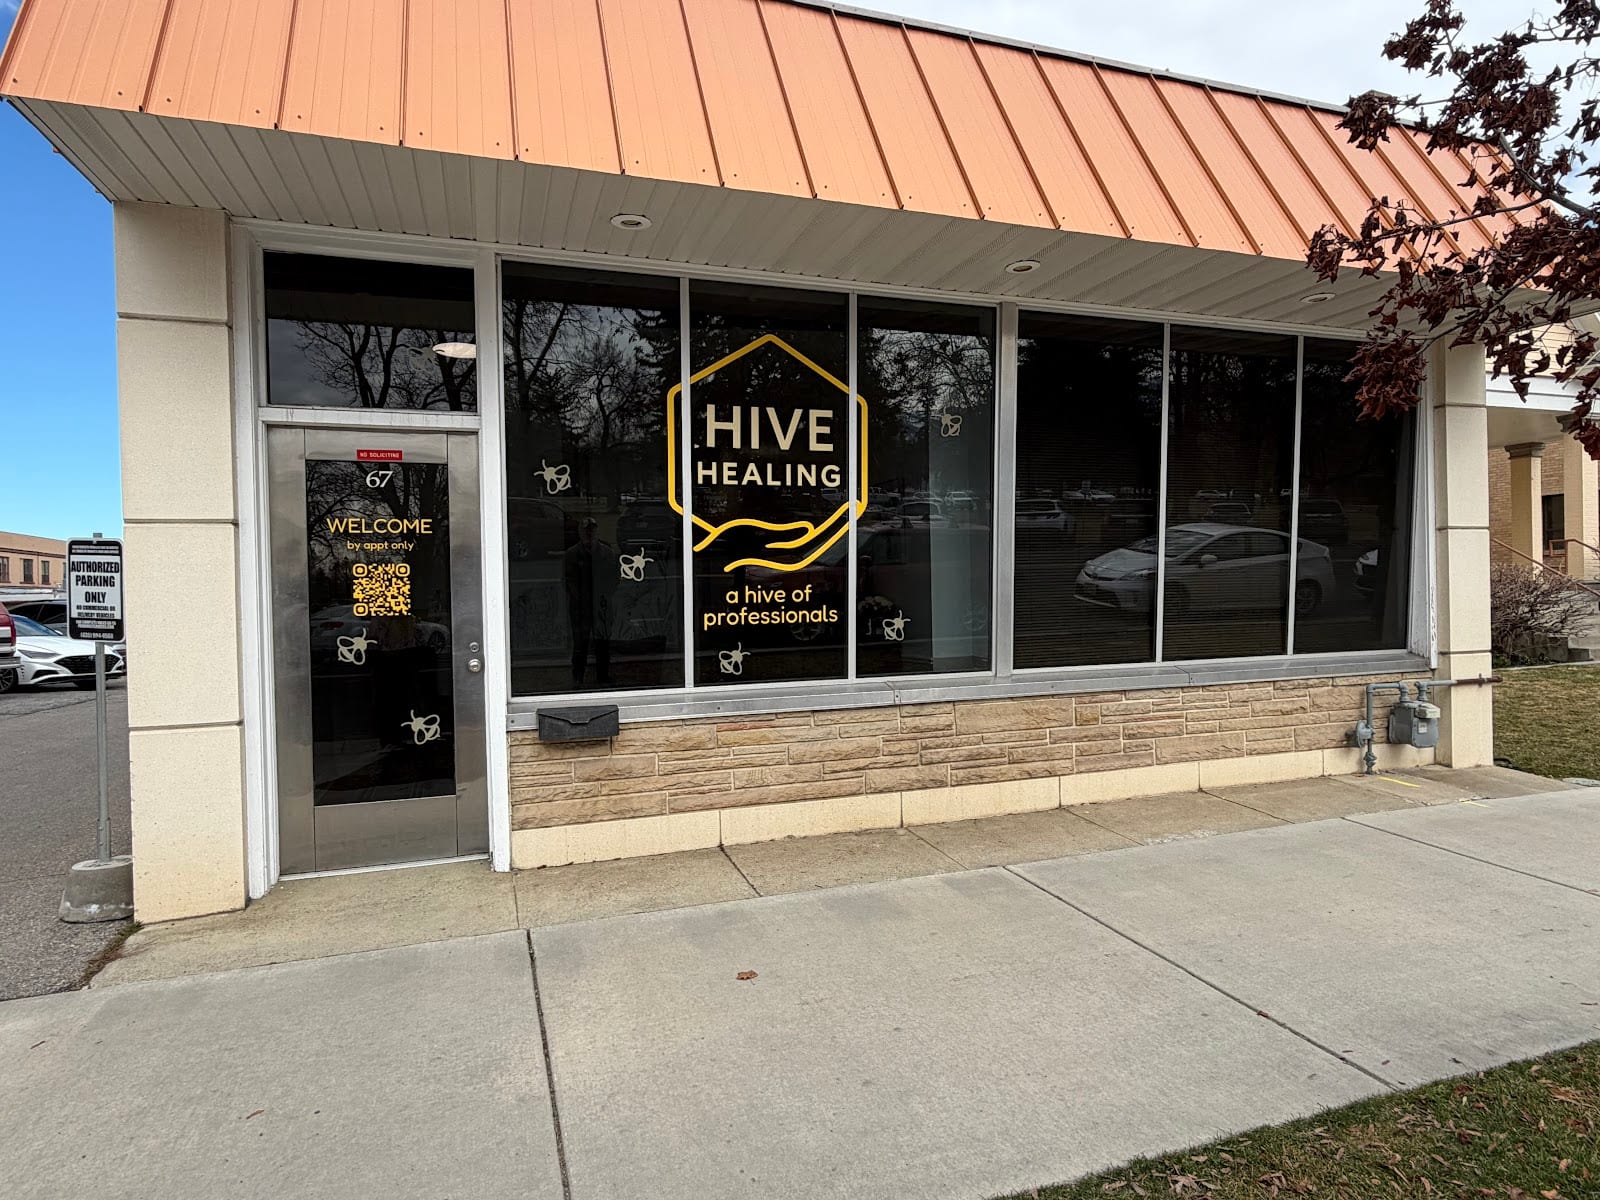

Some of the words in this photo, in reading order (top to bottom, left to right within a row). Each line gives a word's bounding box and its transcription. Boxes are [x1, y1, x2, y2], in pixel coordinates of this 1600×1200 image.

[705, 404, 834, 452] HIVE
[365, 470, 393, 488] 67
[697, 461, 841, 488] HEALING
[326, 518, 433, 534] WELCOME
[347, 540, 360, 551] by
[363, 541, 388, 551] appt
[391, 540, 414, 551] only
[71, 561, 120, 573] AUTHORIZED
[75, 574, 115, 587] PARKING
[85, 591, 107, 603] ONLY
[726, 590, 739, 604] a
[744, 585, 786, 604] hive
[791, 584, 812, 603] of
[703, 604, 839, 631] professionals
